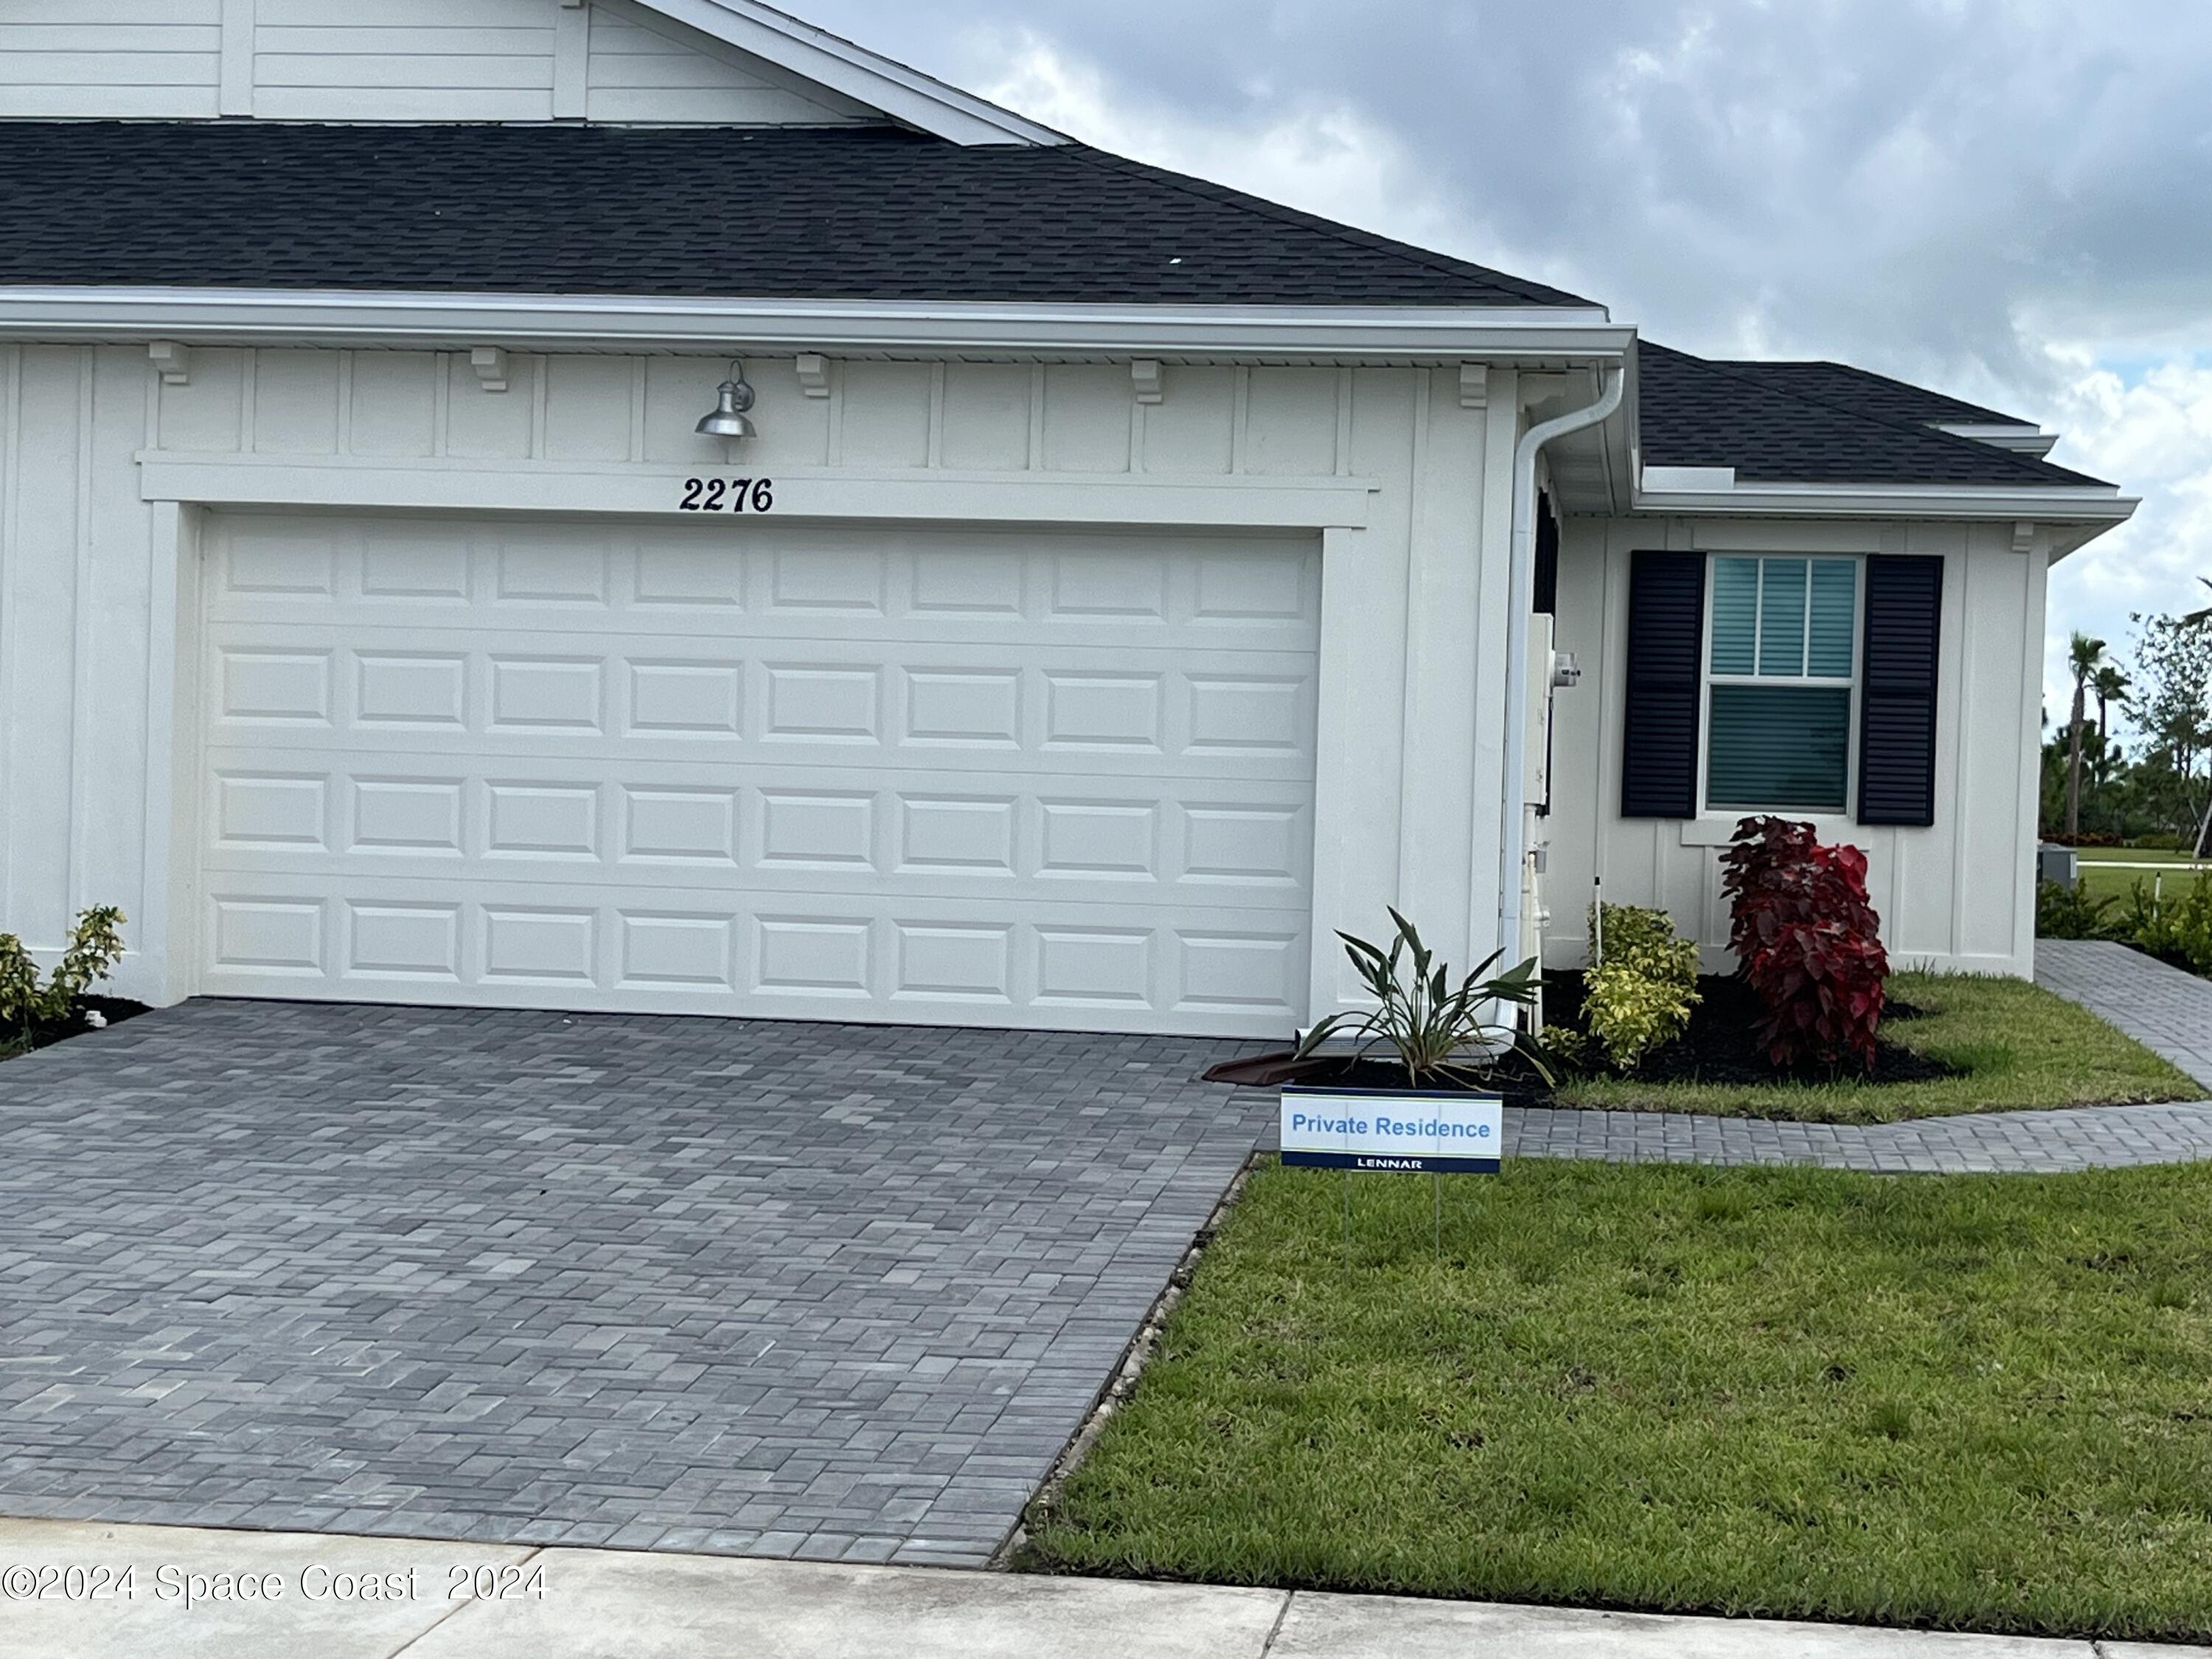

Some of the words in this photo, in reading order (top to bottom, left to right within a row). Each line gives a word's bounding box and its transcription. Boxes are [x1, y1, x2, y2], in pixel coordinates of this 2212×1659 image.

[679, 478, 773, 512] 2276
[1293, 1113, 1368, 1134] Private
[1376, 1117, 1490, 1138] Residence
[1357, 1157, 1422, 1169] LENNAR
